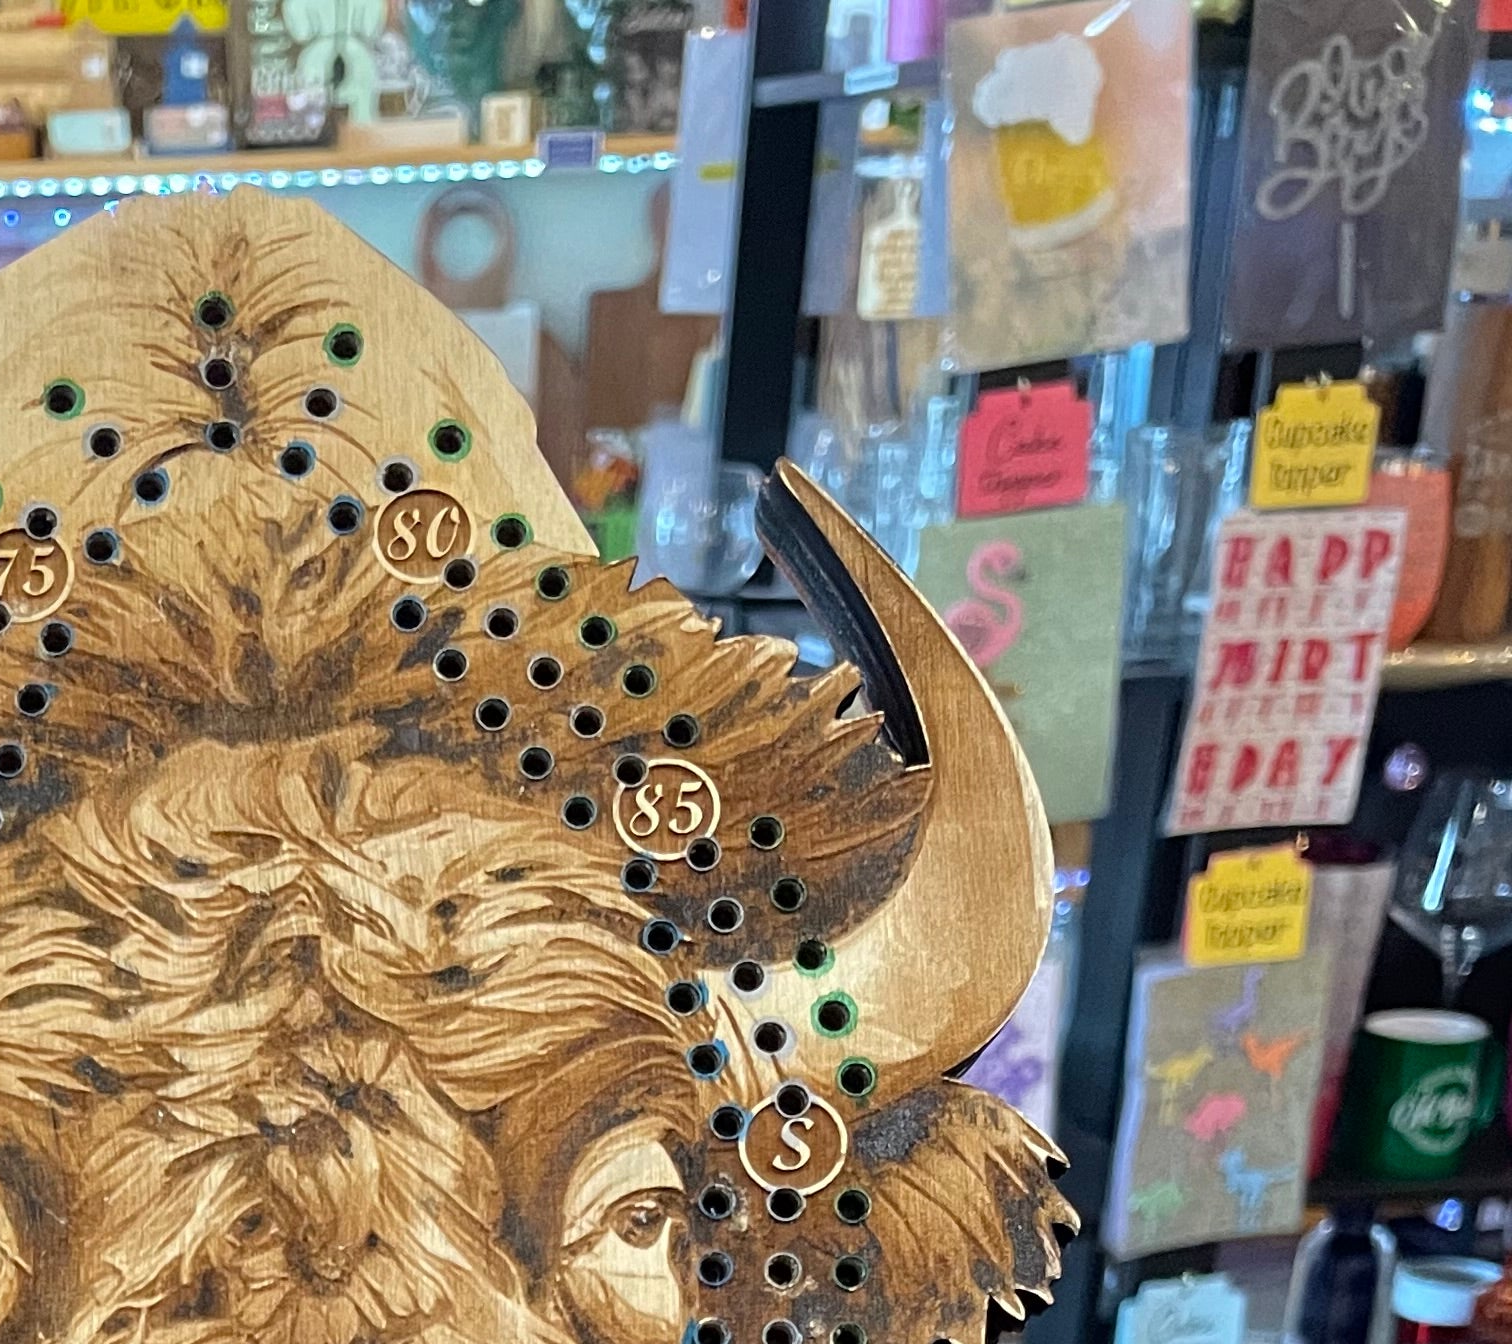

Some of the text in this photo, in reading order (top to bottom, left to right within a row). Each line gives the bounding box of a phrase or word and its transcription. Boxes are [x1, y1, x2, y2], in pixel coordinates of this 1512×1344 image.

[387, 507, 460, 560] 80
[630, 781, 703, 836] 85
[773, 1117, 815, 1170] S
